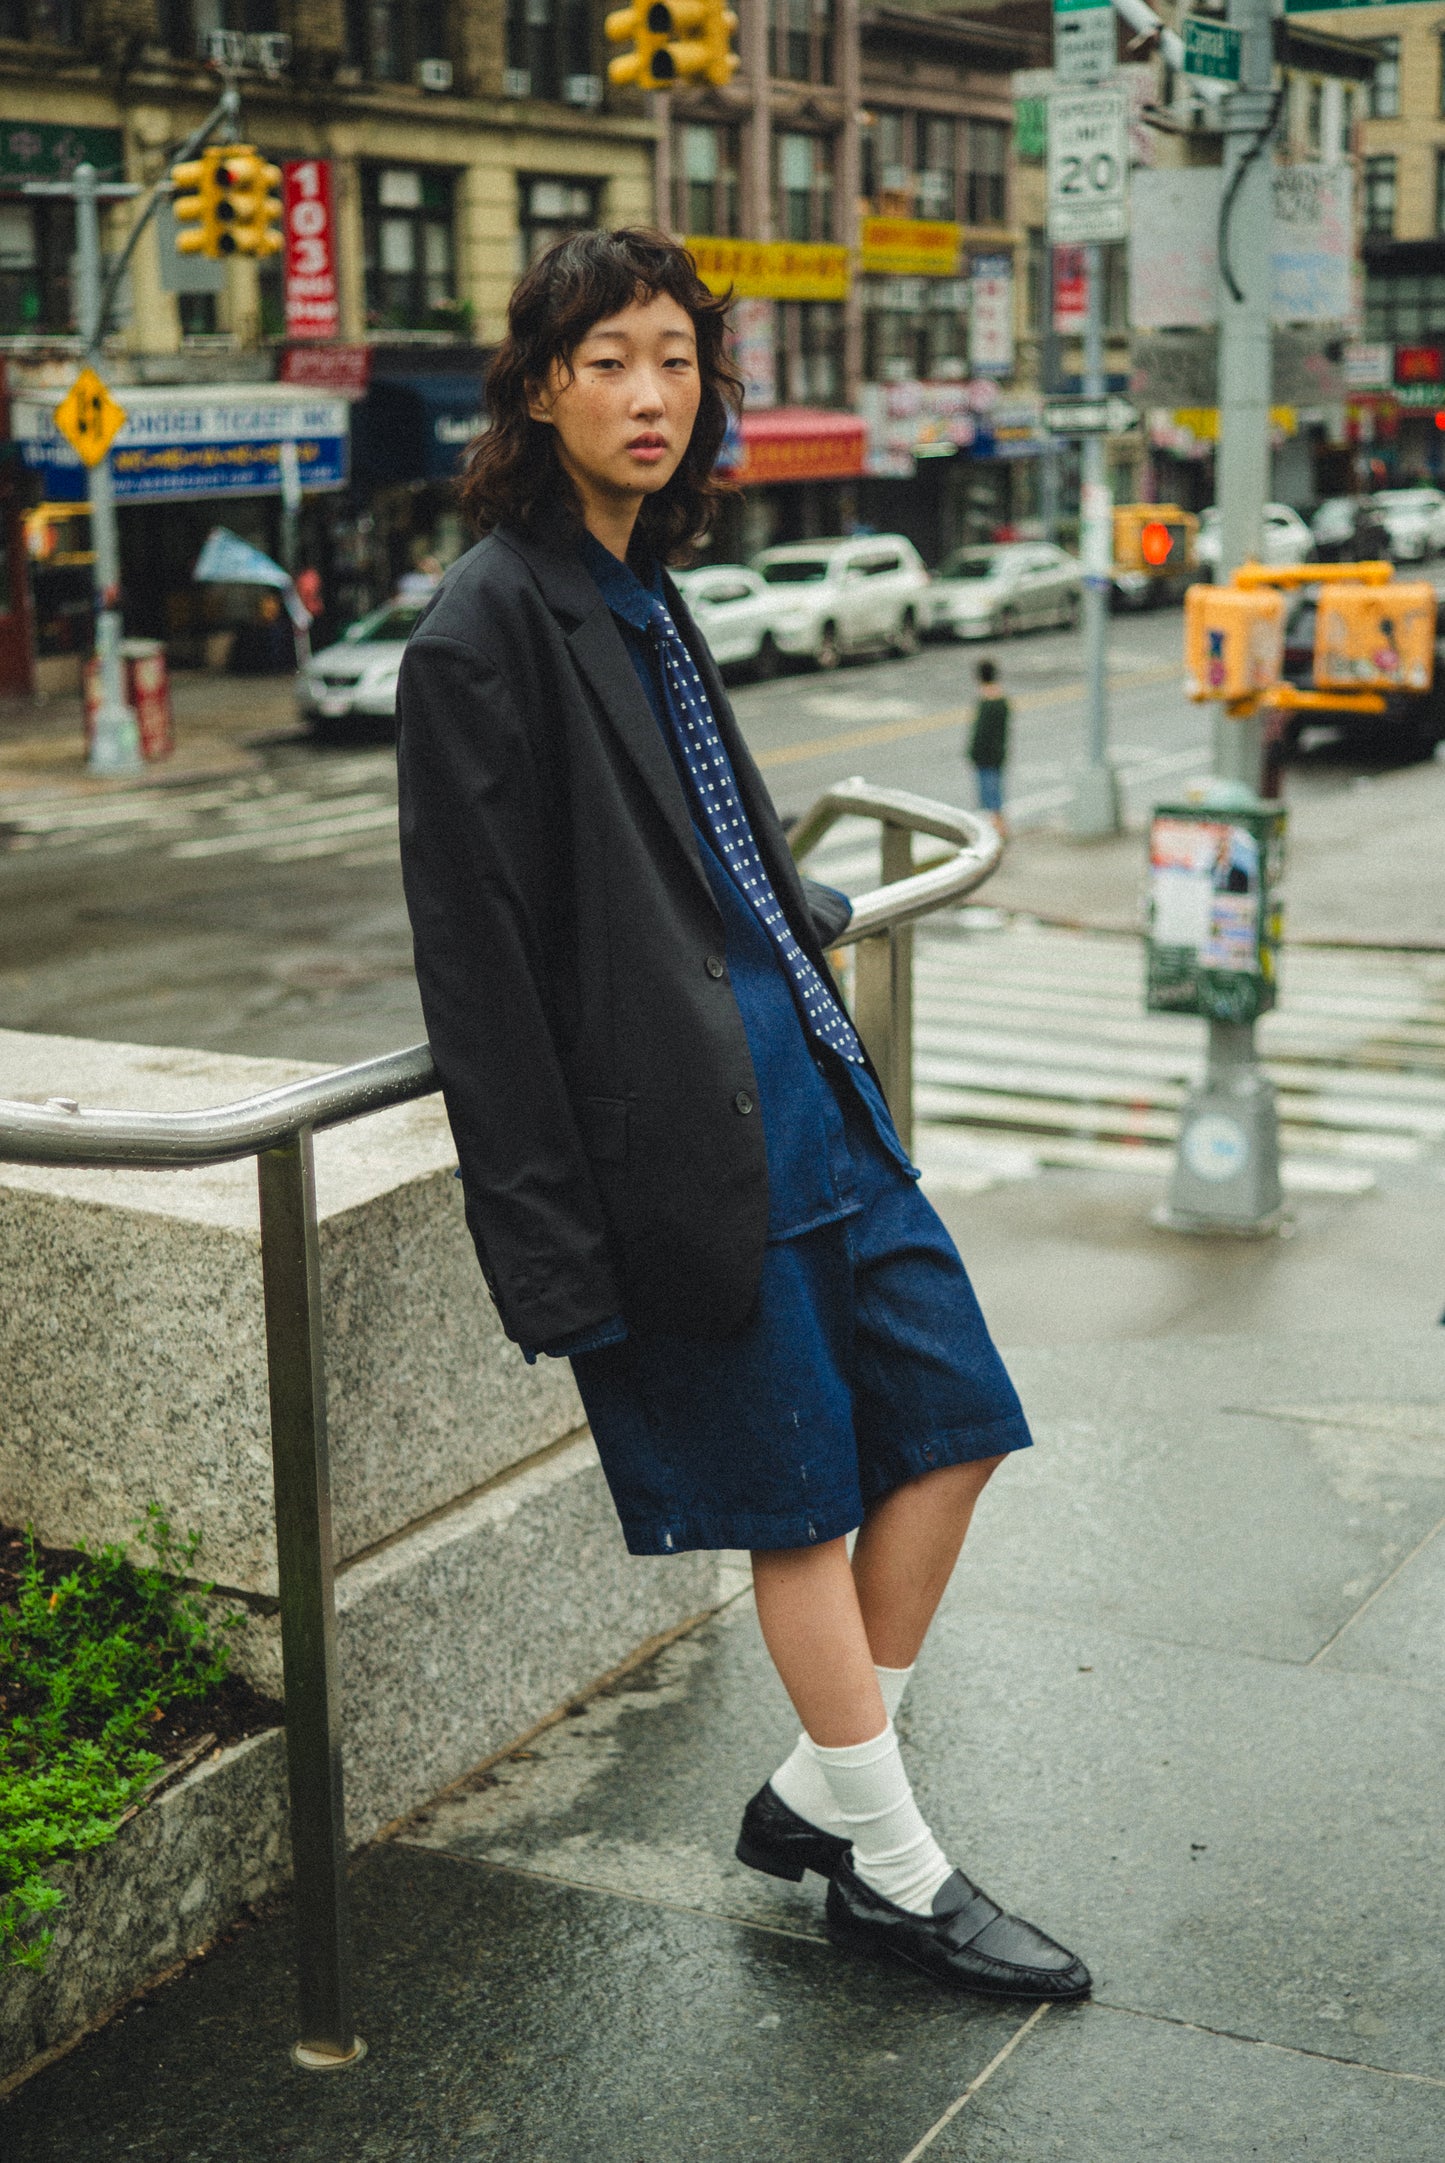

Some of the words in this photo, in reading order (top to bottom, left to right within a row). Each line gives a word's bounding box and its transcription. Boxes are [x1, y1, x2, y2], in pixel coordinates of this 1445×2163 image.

[1058, 102, 1116, 120] SPEED
[1062, 123, 1112, 142] LIMIT
[1061, 153, 1117, 194] 20
[291, 163, 328, 275] 103
[126, 409, 202, 434] ONDER
